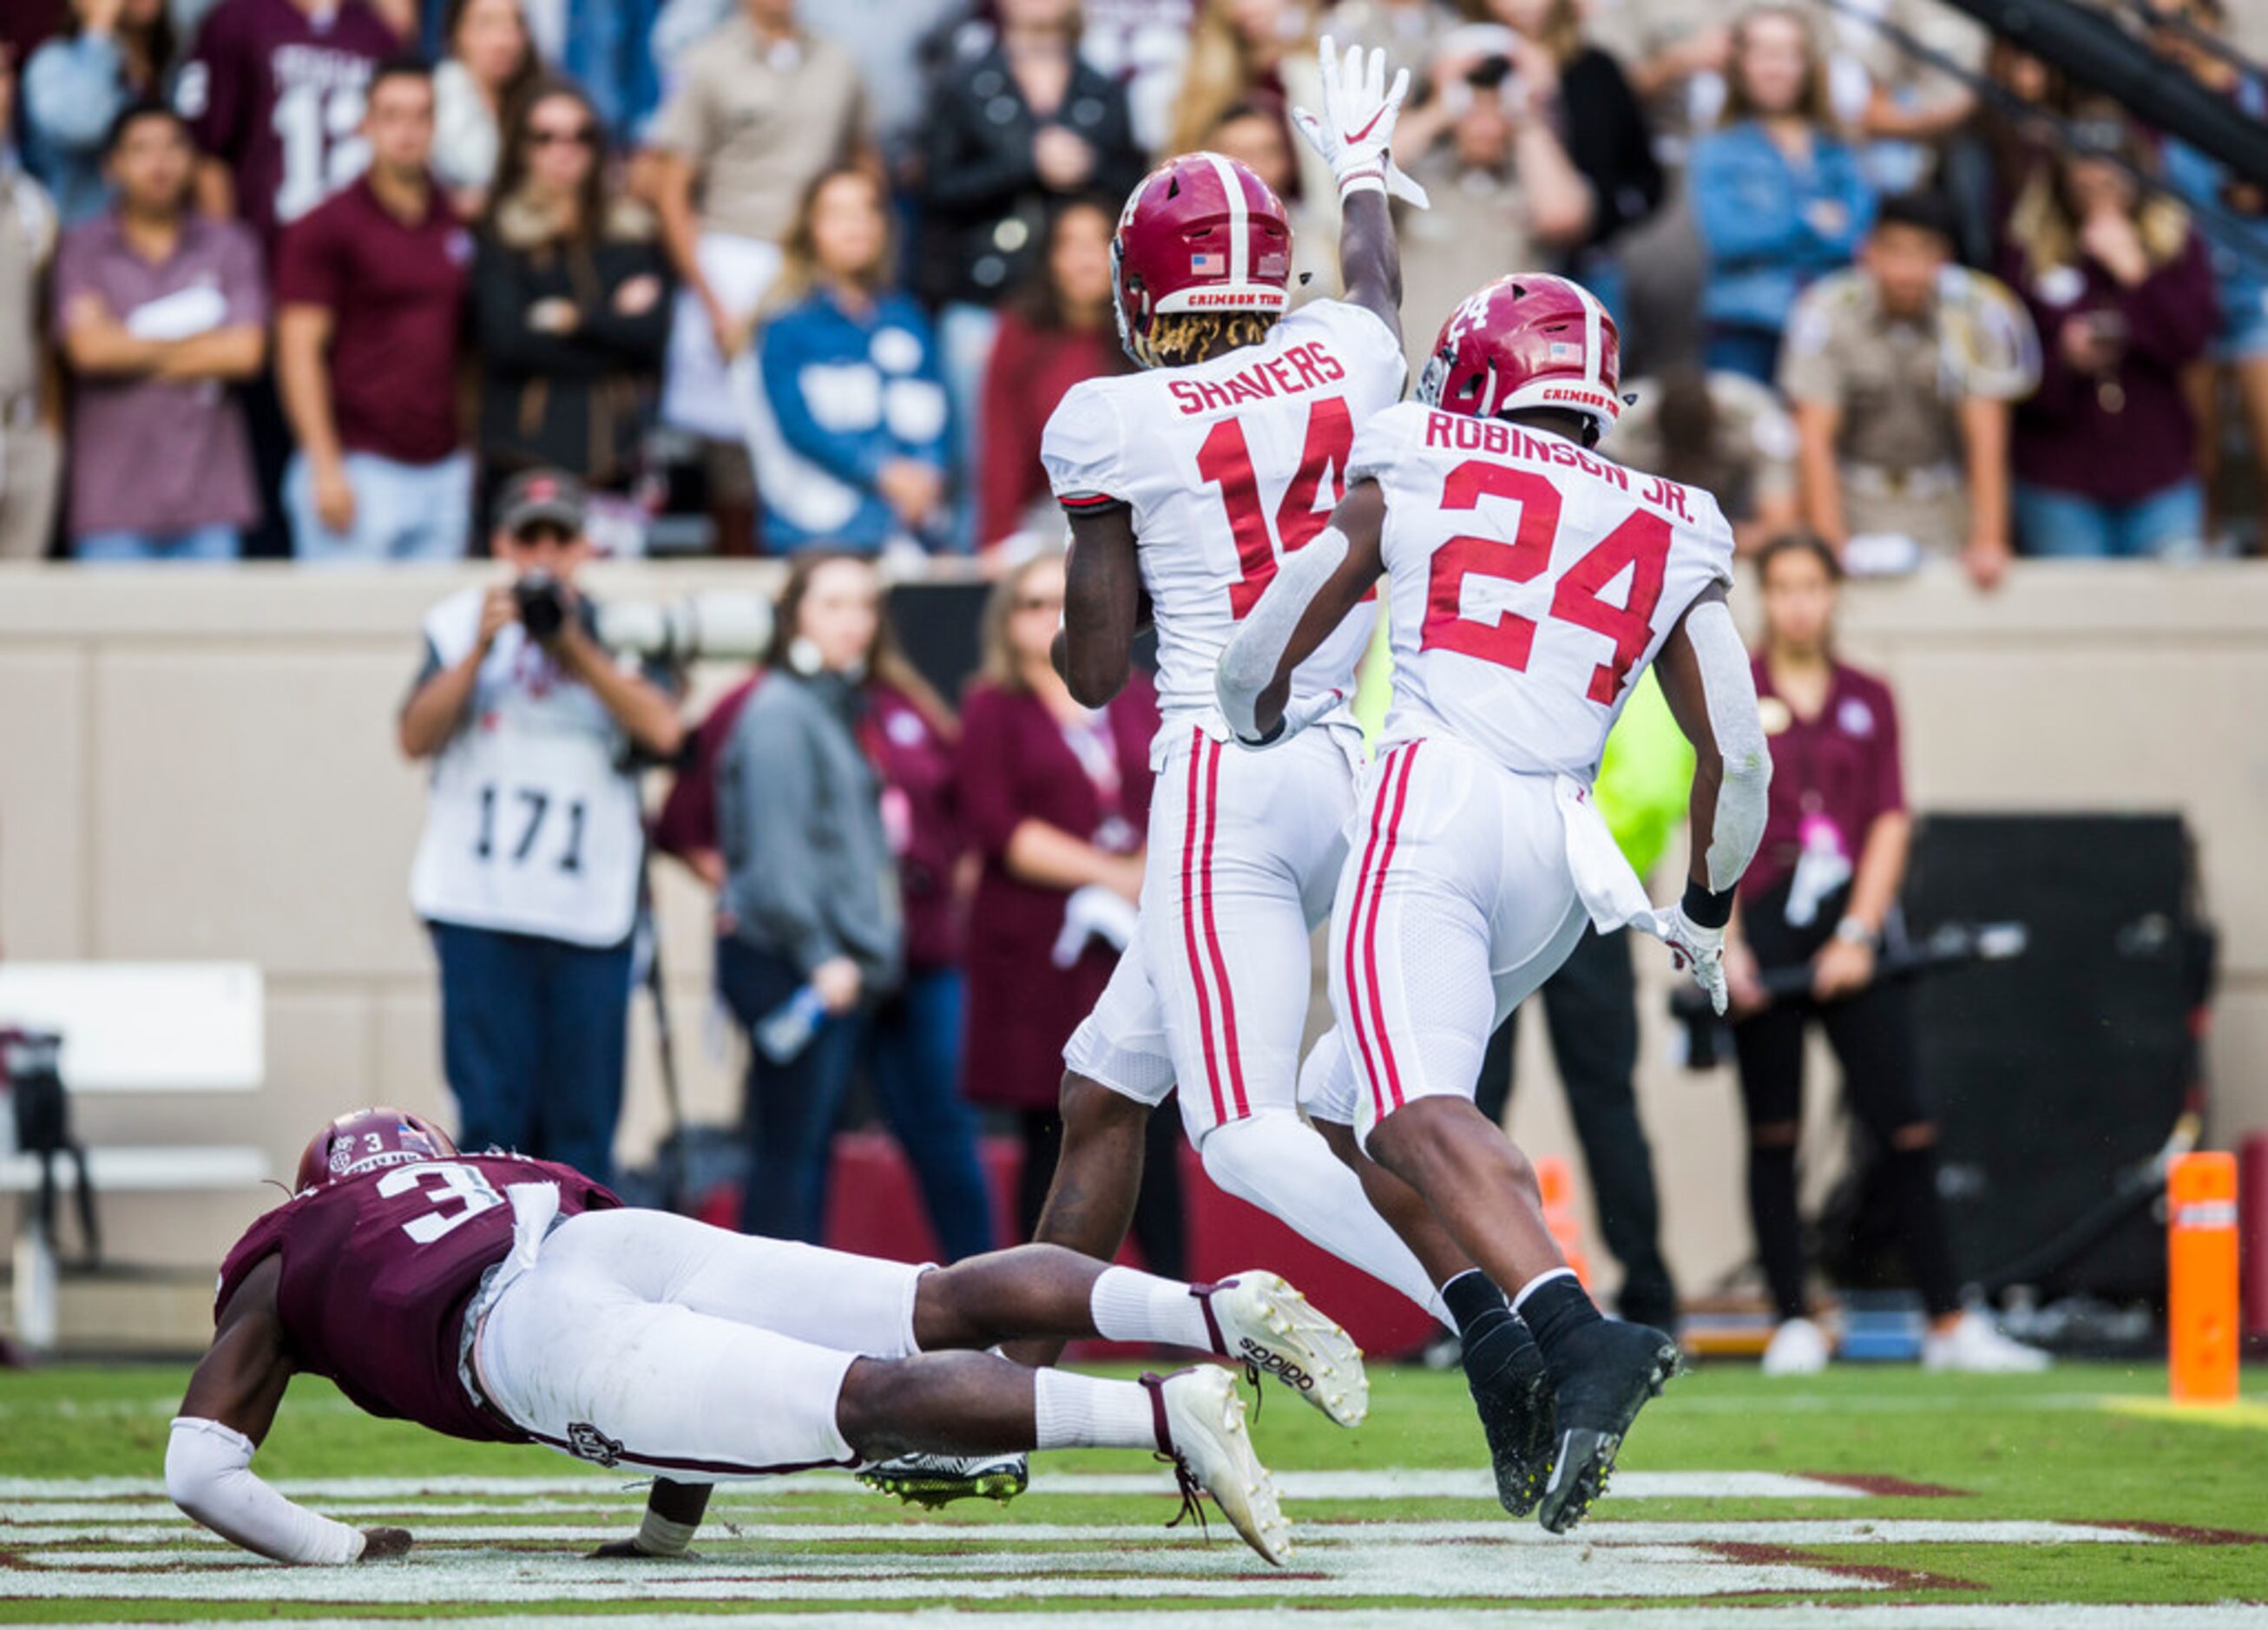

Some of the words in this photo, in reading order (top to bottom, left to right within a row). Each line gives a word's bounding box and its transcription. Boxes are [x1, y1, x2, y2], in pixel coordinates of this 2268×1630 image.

[1167, 341, 1345, 415] SHAVERS
[1196, 395, 1378, 621] 14
[1425, 411, 1629, 492] ROBINSON
[1642, 477, 1696, 523] JR.
[1418, 458, 1674, 708] 24
[476, 786, 584, 871] 171
[364, 1132, 384, 1153] 3
[375, 1162, 505, 1244] 3
[1239, 1337, 1314, 1391] adidas
